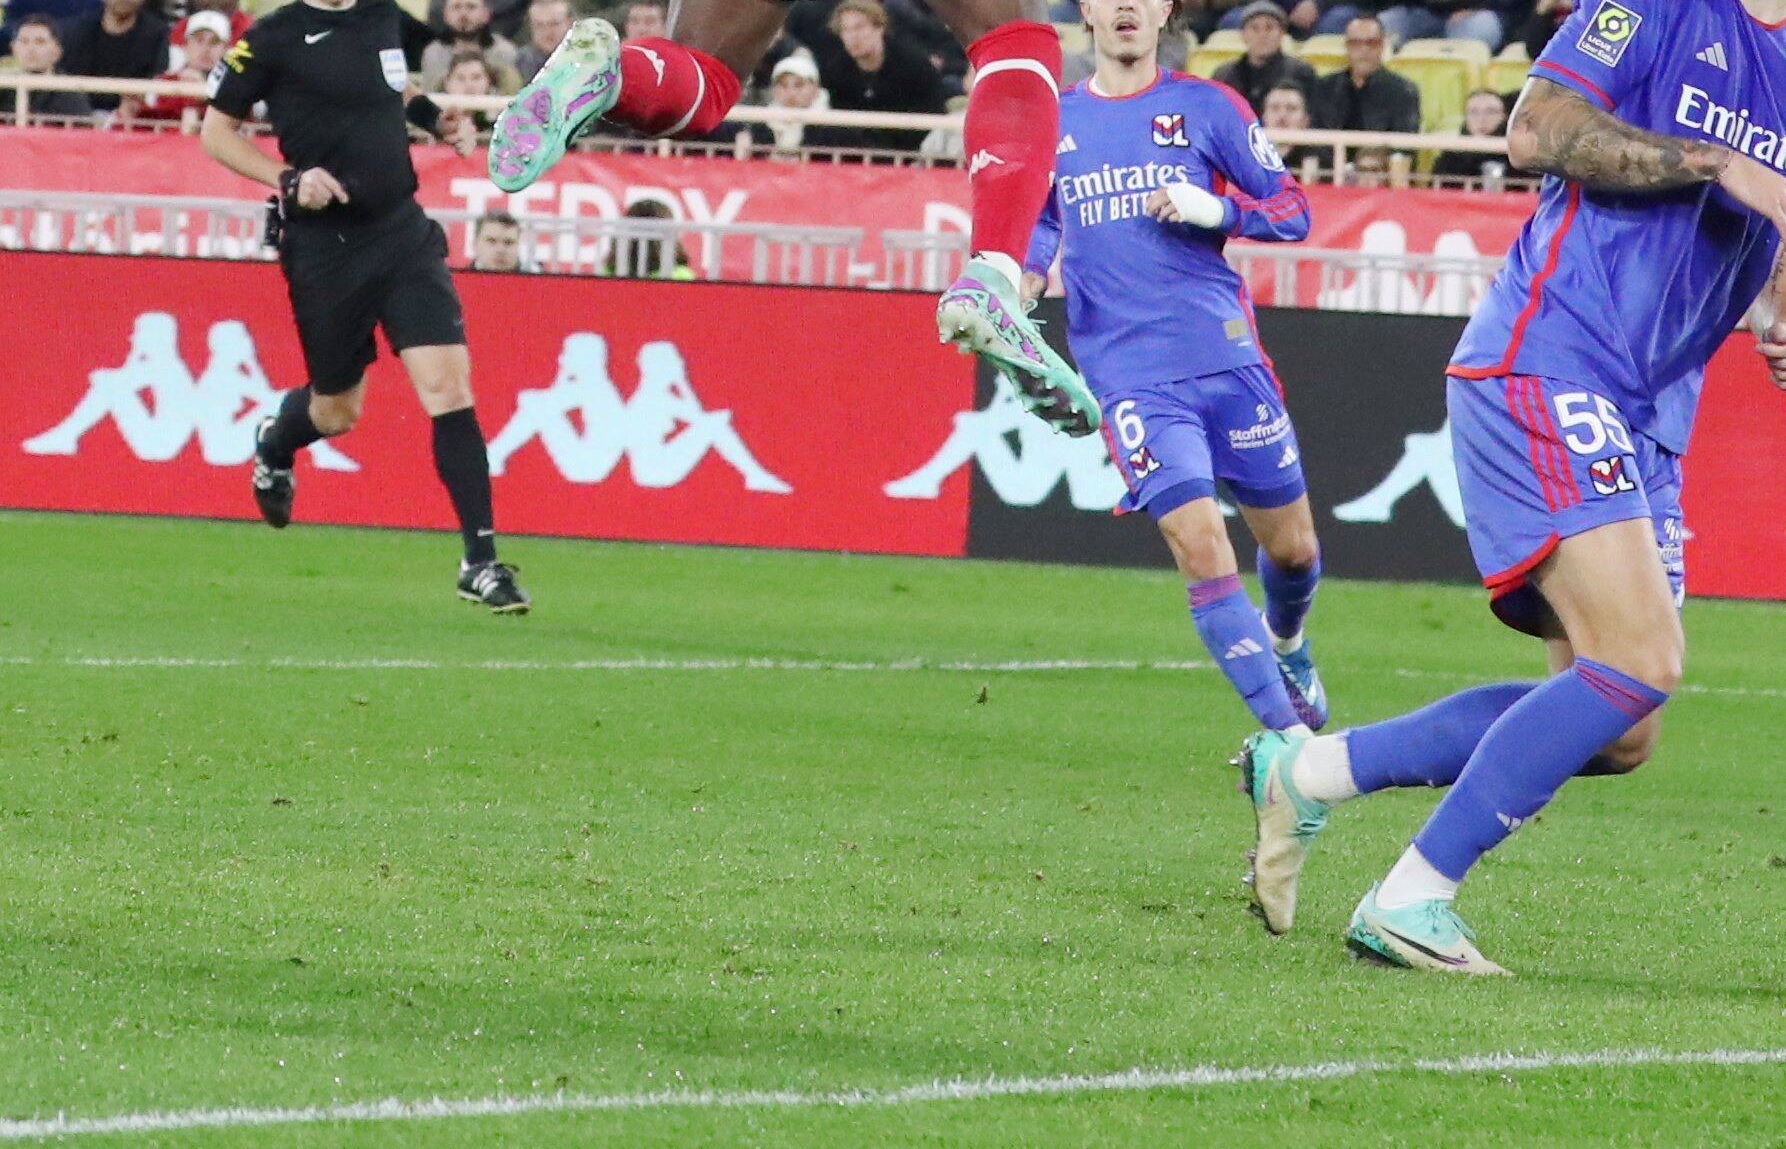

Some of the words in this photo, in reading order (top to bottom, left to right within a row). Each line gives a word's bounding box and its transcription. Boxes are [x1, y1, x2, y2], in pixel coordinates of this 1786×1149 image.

[1152, 113, 1191, 148] OL
[1060, 160, 1188, 205] Emirates
[1080, 198, 1104, 228] FLY
[1109, 190, 1155, 222] BETT
[1114, 399, 1145, 451] 6
[1552, 392, 1636, 456] 55
